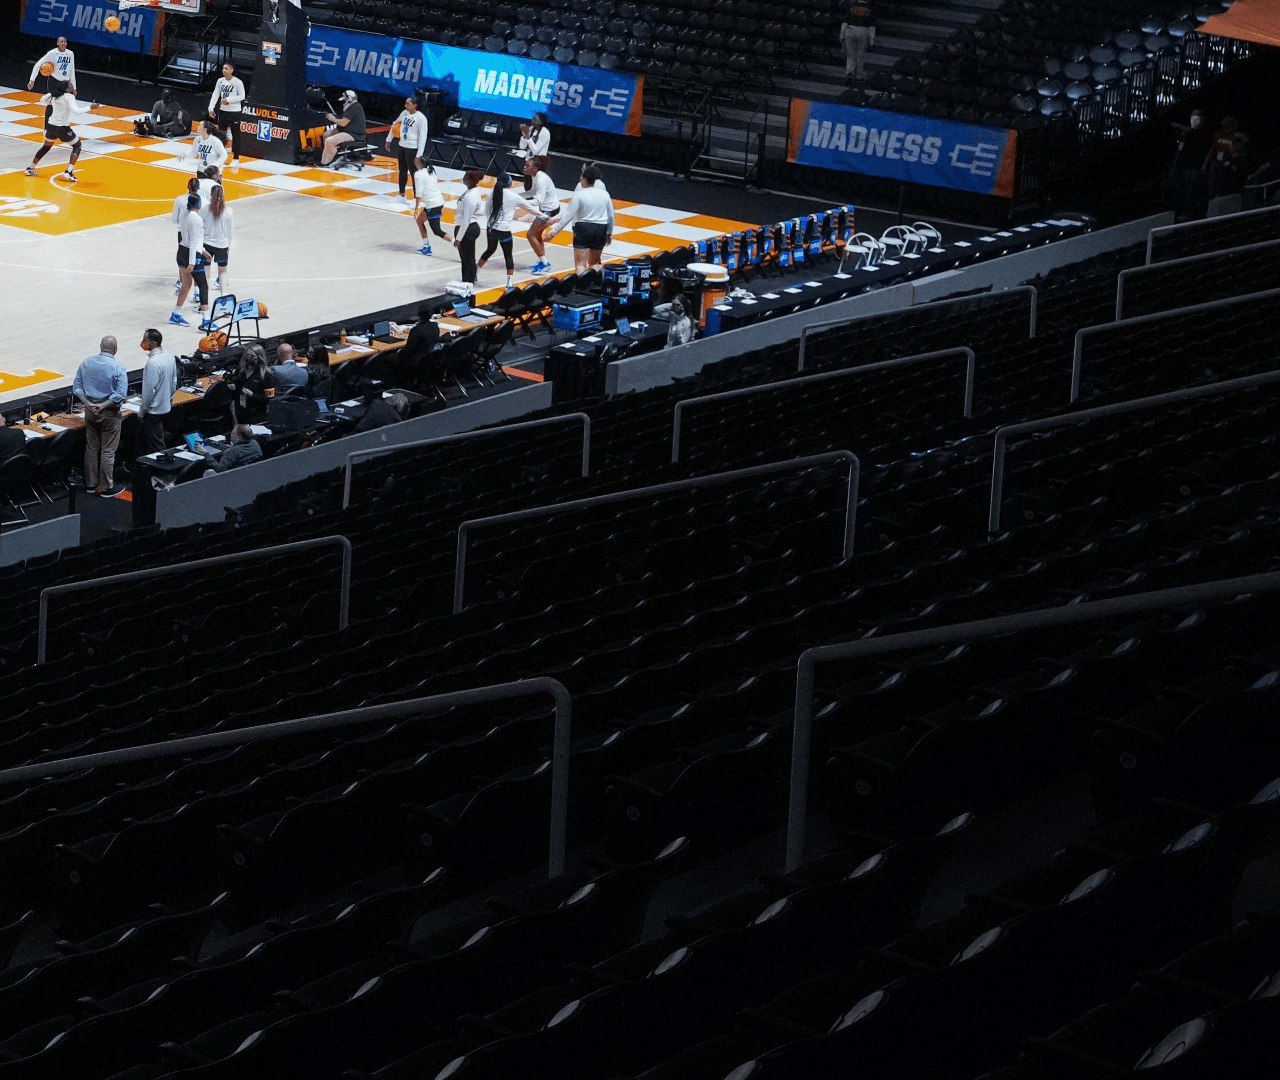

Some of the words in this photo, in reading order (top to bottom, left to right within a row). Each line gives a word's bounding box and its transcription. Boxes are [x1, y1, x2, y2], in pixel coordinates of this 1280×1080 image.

[344, 48, 423, 83] MARCH
[474, 69, 585, 108] MADNESS
[240, 121, 258, 135] OOD
[271, 127, 290, 140] CITY
[242, 105, 289, 121] ALLVOLS.COM
[804, 119, 943, 166] MADNESS
